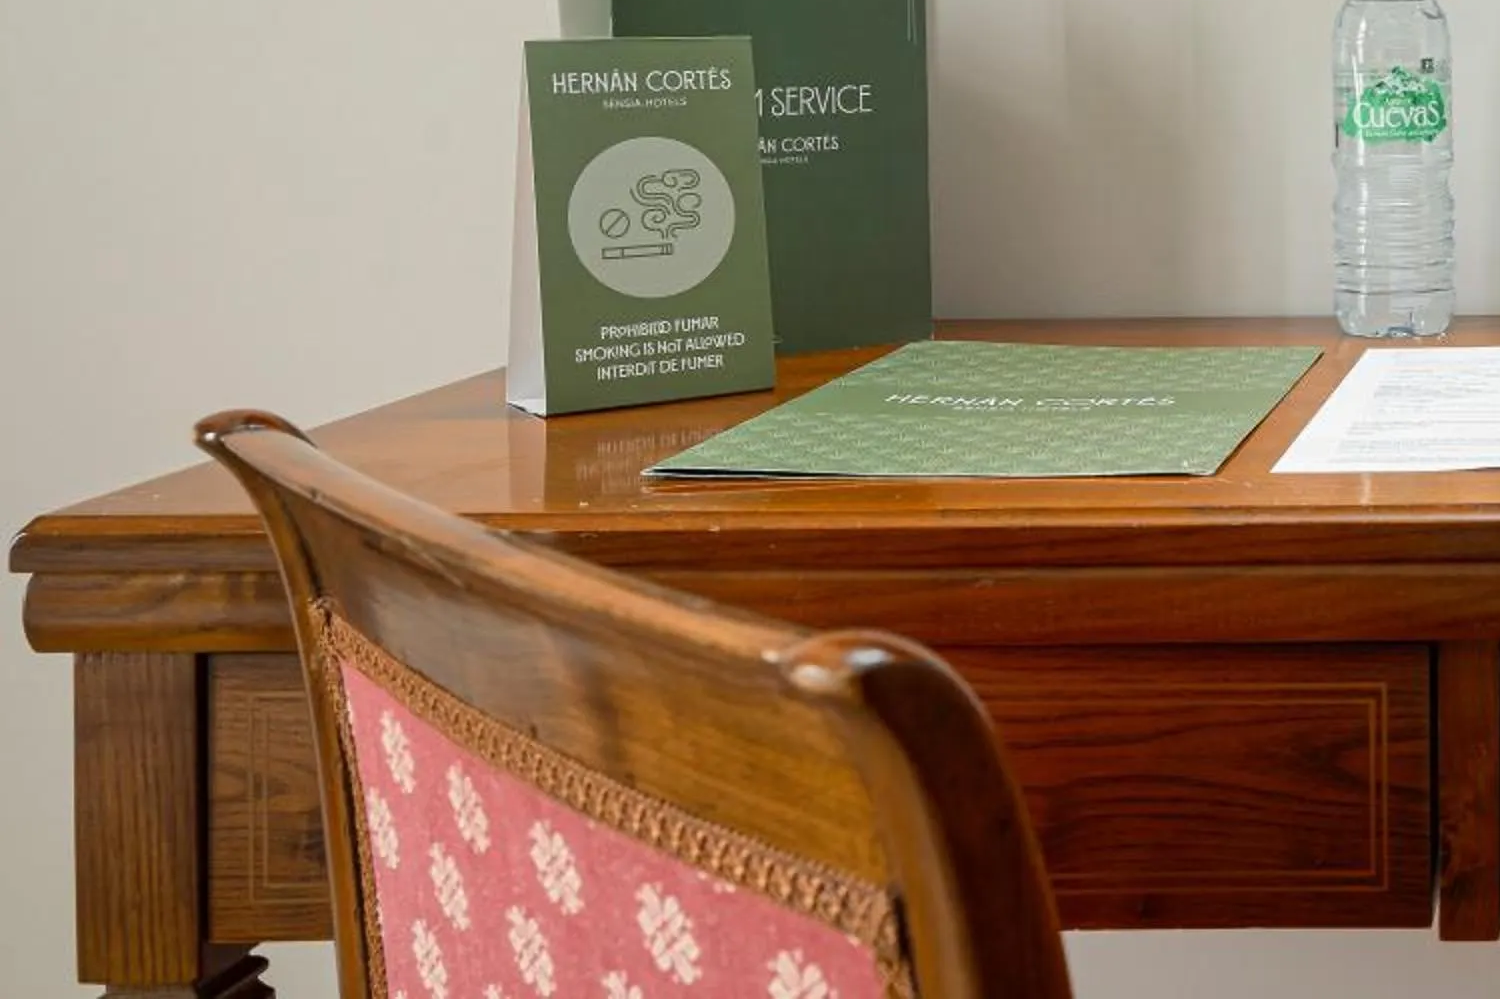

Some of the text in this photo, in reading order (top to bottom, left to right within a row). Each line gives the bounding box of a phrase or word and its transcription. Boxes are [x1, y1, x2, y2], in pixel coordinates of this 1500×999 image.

[553, 66, 732, 94] HERNÁN CORTÉS
[771, 84, 873, 116] SERVICE
[601, 316, 719, 339] PROHIBIDO FUMAR
[575, 342, 641, 363] SMOKING
[643, 342, 655, 356] IS
[685, 332, 745, 351] ALLOWED
[597, 354, 723, 380] INTERDIT DE FUMER
